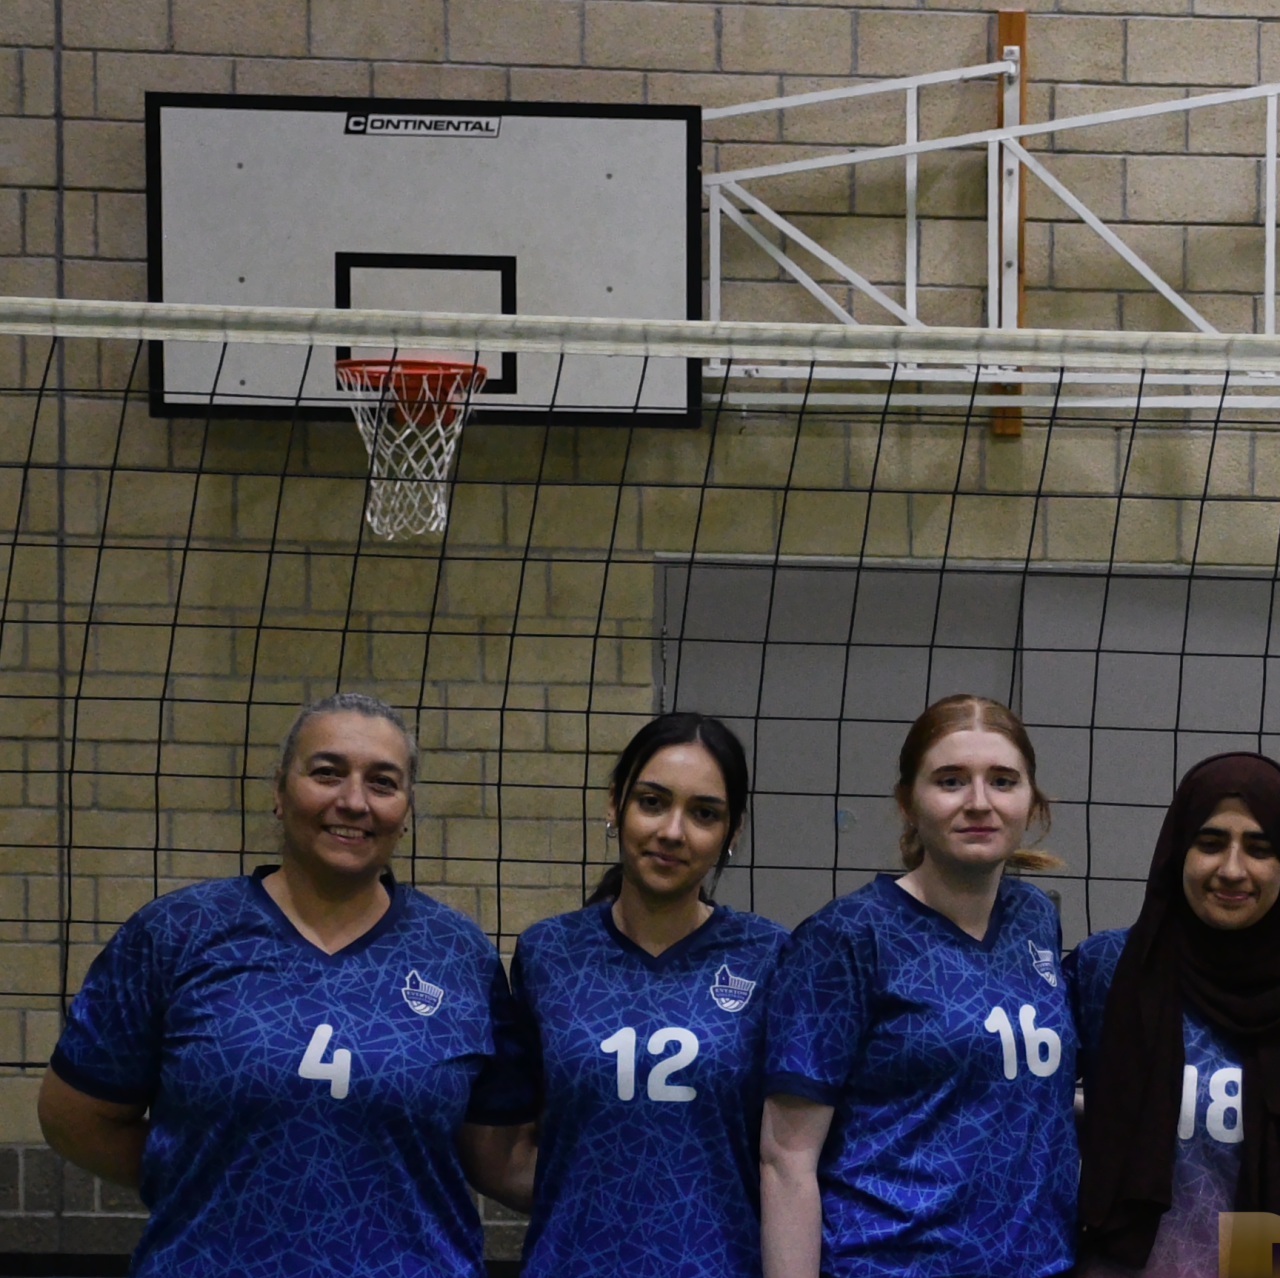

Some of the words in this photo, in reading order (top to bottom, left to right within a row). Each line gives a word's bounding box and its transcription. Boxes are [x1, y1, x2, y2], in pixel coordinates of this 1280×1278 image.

[347, 116, 496, 133] CONTINENTAL
[298, 1024, 351, 1099] 4
[600, 1027, 699, 1102] 12
[984, 1004, 1061, 1080] 16
[1177, 1064, 1244, 1144] 18
